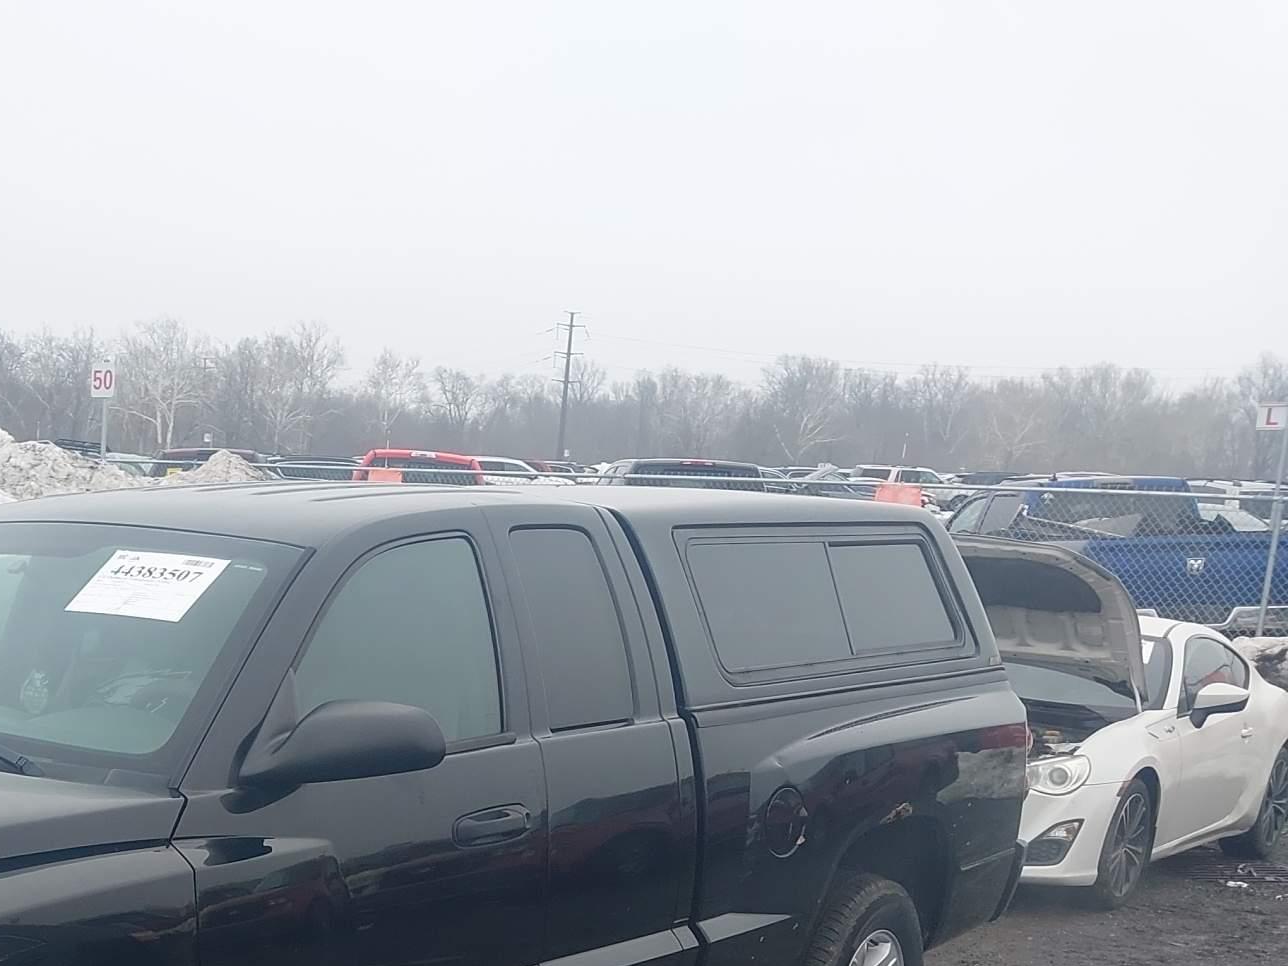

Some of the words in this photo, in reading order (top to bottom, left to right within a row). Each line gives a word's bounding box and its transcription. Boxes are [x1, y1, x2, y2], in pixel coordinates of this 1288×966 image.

[93, 369, 113, 390] 50
[1265, 407, 1279, 426] L
[110, 565, 204, 583] 44383507
